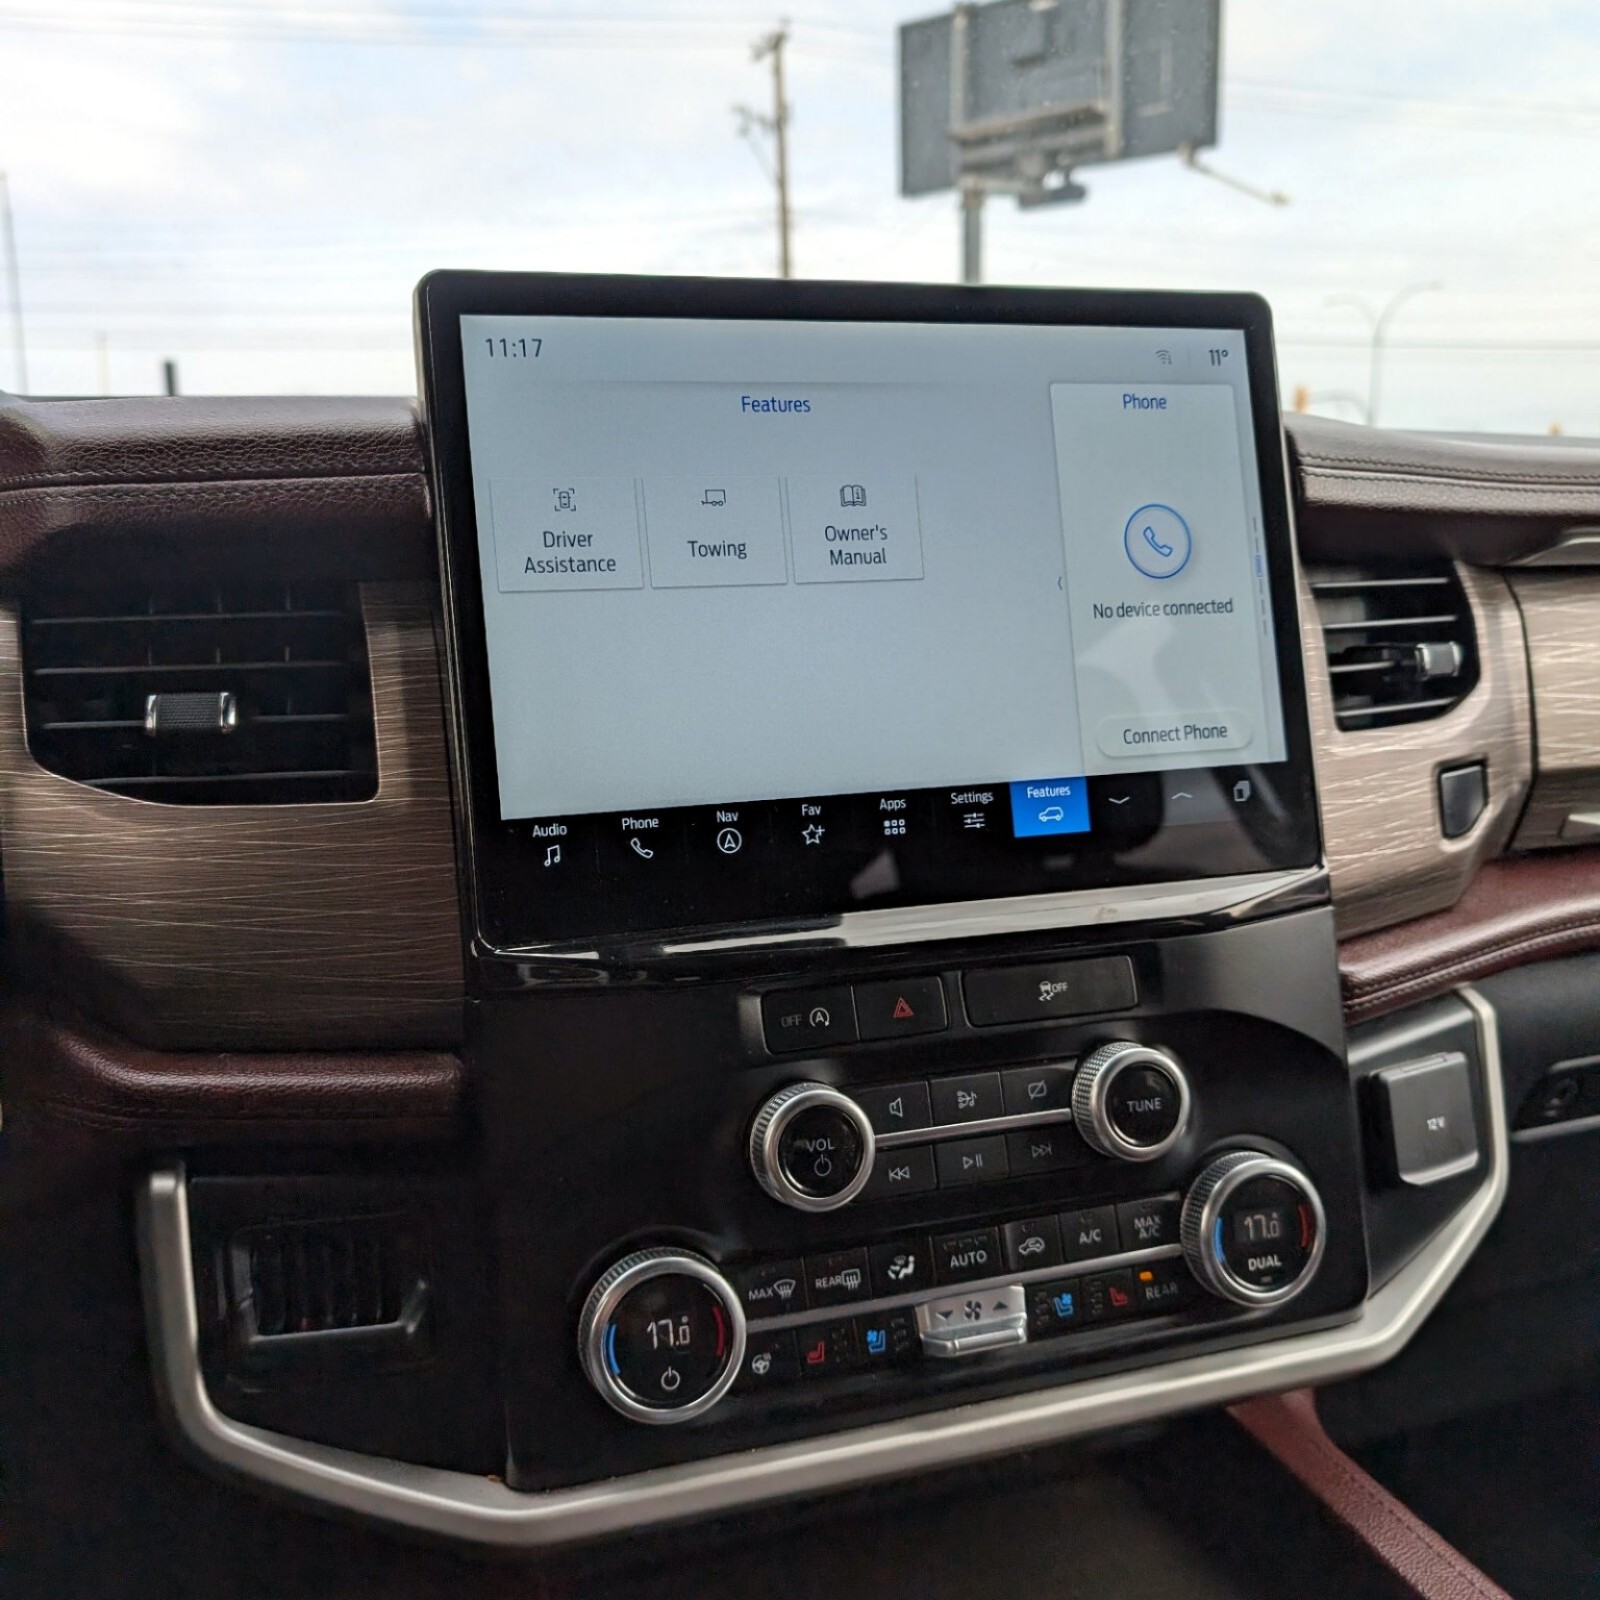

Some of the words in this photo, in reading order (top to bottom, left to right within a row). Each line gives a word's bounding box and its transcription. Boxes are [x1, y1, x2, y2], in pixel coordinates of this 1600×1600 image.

[485, 338, 543, 358] 11:17
[741, 396, 811, 414] Features
[1122, 394, 1167, 411] Phone
[542, 531, 594, 549] Driver
[824, 524, 888, 542] Owner's
[687, 540, 748, 560] Towing
[829, 548, 886, 567] Manual
[524, 554, 617, 575] Assistance
[1093, 603, 1113, 619] No
[1116, 600, 1161, 618] device
[1163, 598, 1234, 616] connected
[1123, 726, 1181, 745] Connect
[1184, 723, 1228, 741] Phone
[950, 790, 993, 806] Settings
[1026, 784, 1071, 799] Features
[801, 804, 822, 817] Fav
[879, 798, 907, 813] Apps
[621, 816, 659, 830] Phone
[716, 810, 739, 824] Nav
[532, 823, 568, 838] Audio
[1051, 981, 1068, 994] OFF
[781, 1014, 802, 1027] OFF
[1126, 1097, 1163, 1112] TUNE
[806, 1138, 834, 1153] VOL
[1135, 1215, 1161, 1230] MAX
[1079, 1229, 1102, 1244] A/C
[1139, 1226, 1160, 1239] A/C
[950, 1250, 987, 1268] AUTO
[1248, 1255, 1282, 1271] DUAL
[815, 1276, 842, 1289] REAR
[749, 1287, 773, 1301] MAX
